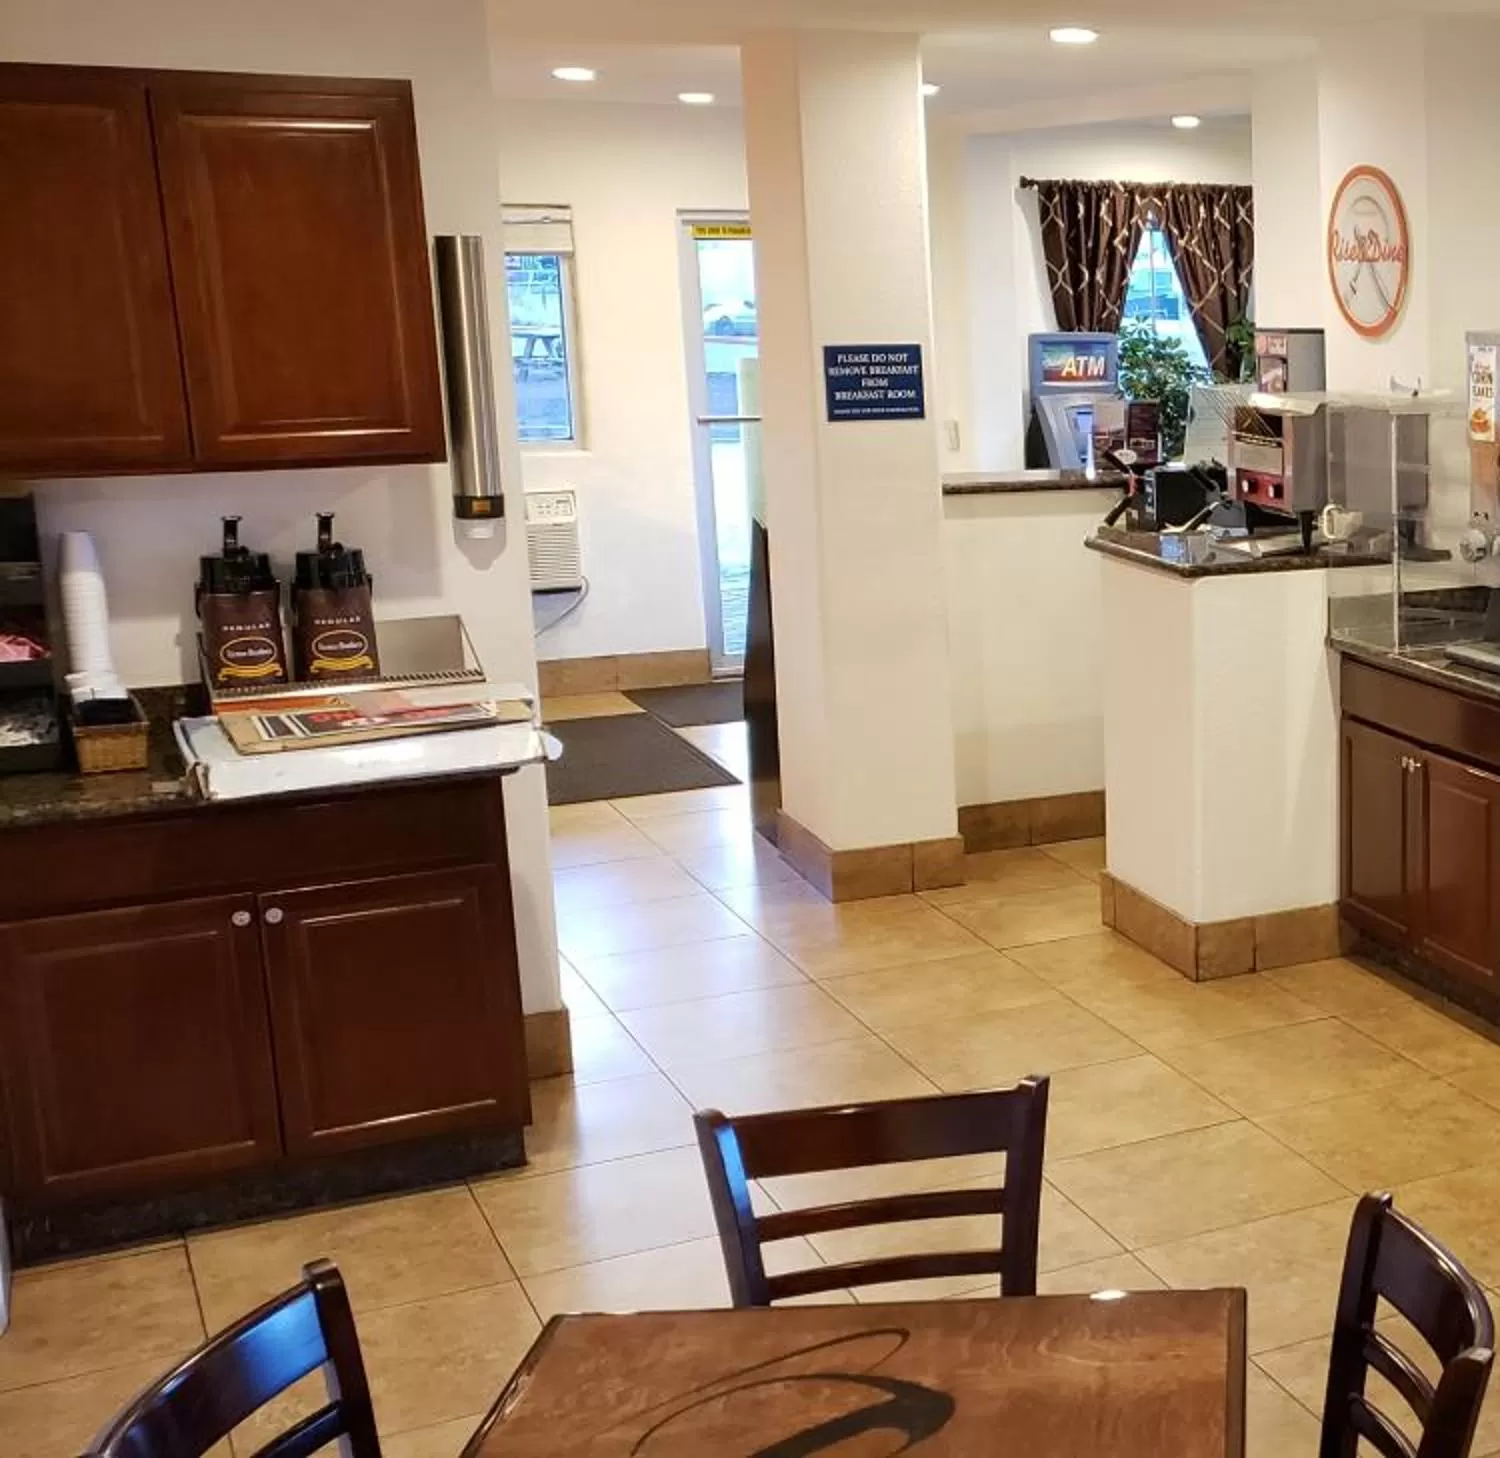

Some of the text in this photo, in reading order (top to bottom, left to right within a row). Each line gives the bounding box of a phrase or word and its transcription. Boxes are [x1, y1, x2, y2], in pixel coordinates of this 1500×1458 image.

[837, 353, 908, 364] PLEASE DO NOT
[828, 365, 919, 377] REMOVE BREAKFAST
[1061, 355, 1105, 377] ATM
[861, 378, 889, 388] FROM
[834, 390, 917, 401] BREAKFAST ROOM
